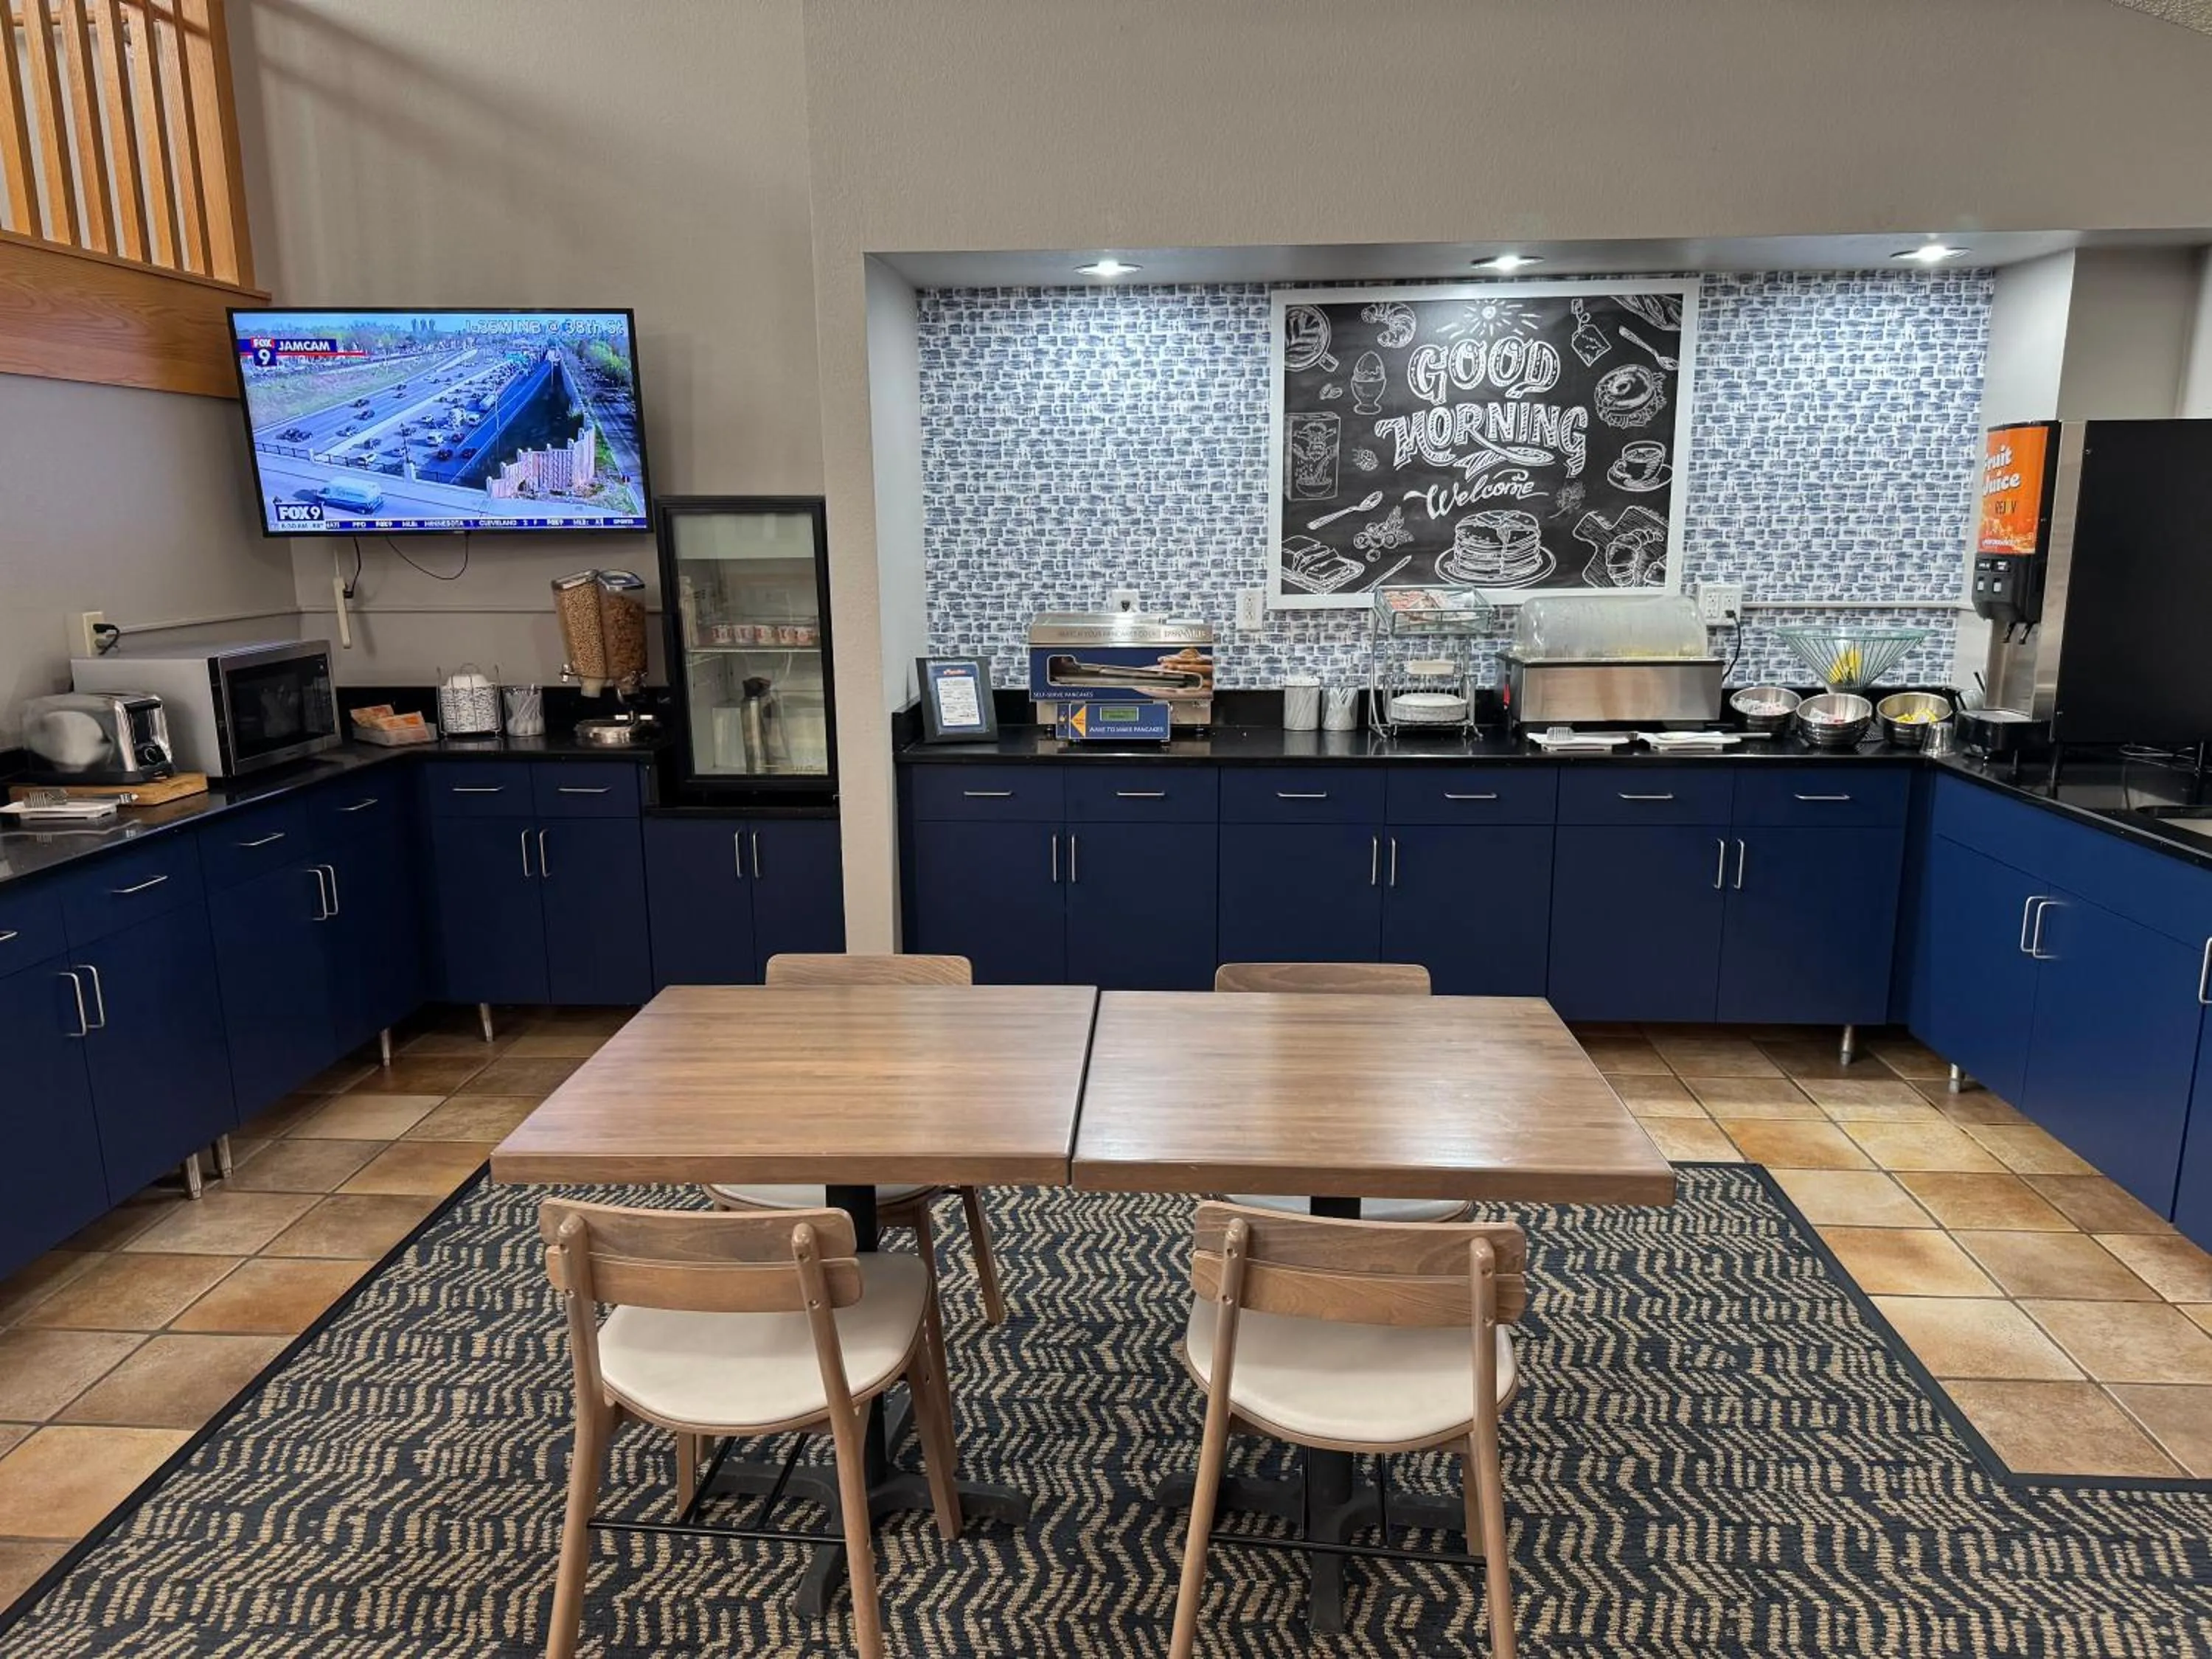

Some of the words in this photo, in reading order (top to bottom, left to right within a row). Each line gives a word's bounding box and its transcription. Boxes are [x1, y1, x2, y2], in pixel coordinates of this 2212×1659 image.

[518, 320, 542, 335] NB
[547, 320, 560, 335] @
[565, 319, 601, 336] 38th
[606, 319, 625, 336] St
[252, 338, 273, 348] FOX
[278, 341, 331, 351] JAMCAM
[258, 349, 271, 365] 9
[1407, 336, 1561, 405] GOOD
[1375, 400, 1589, 481] MORNING
[1403, 469, 1550, 520] Welcome
